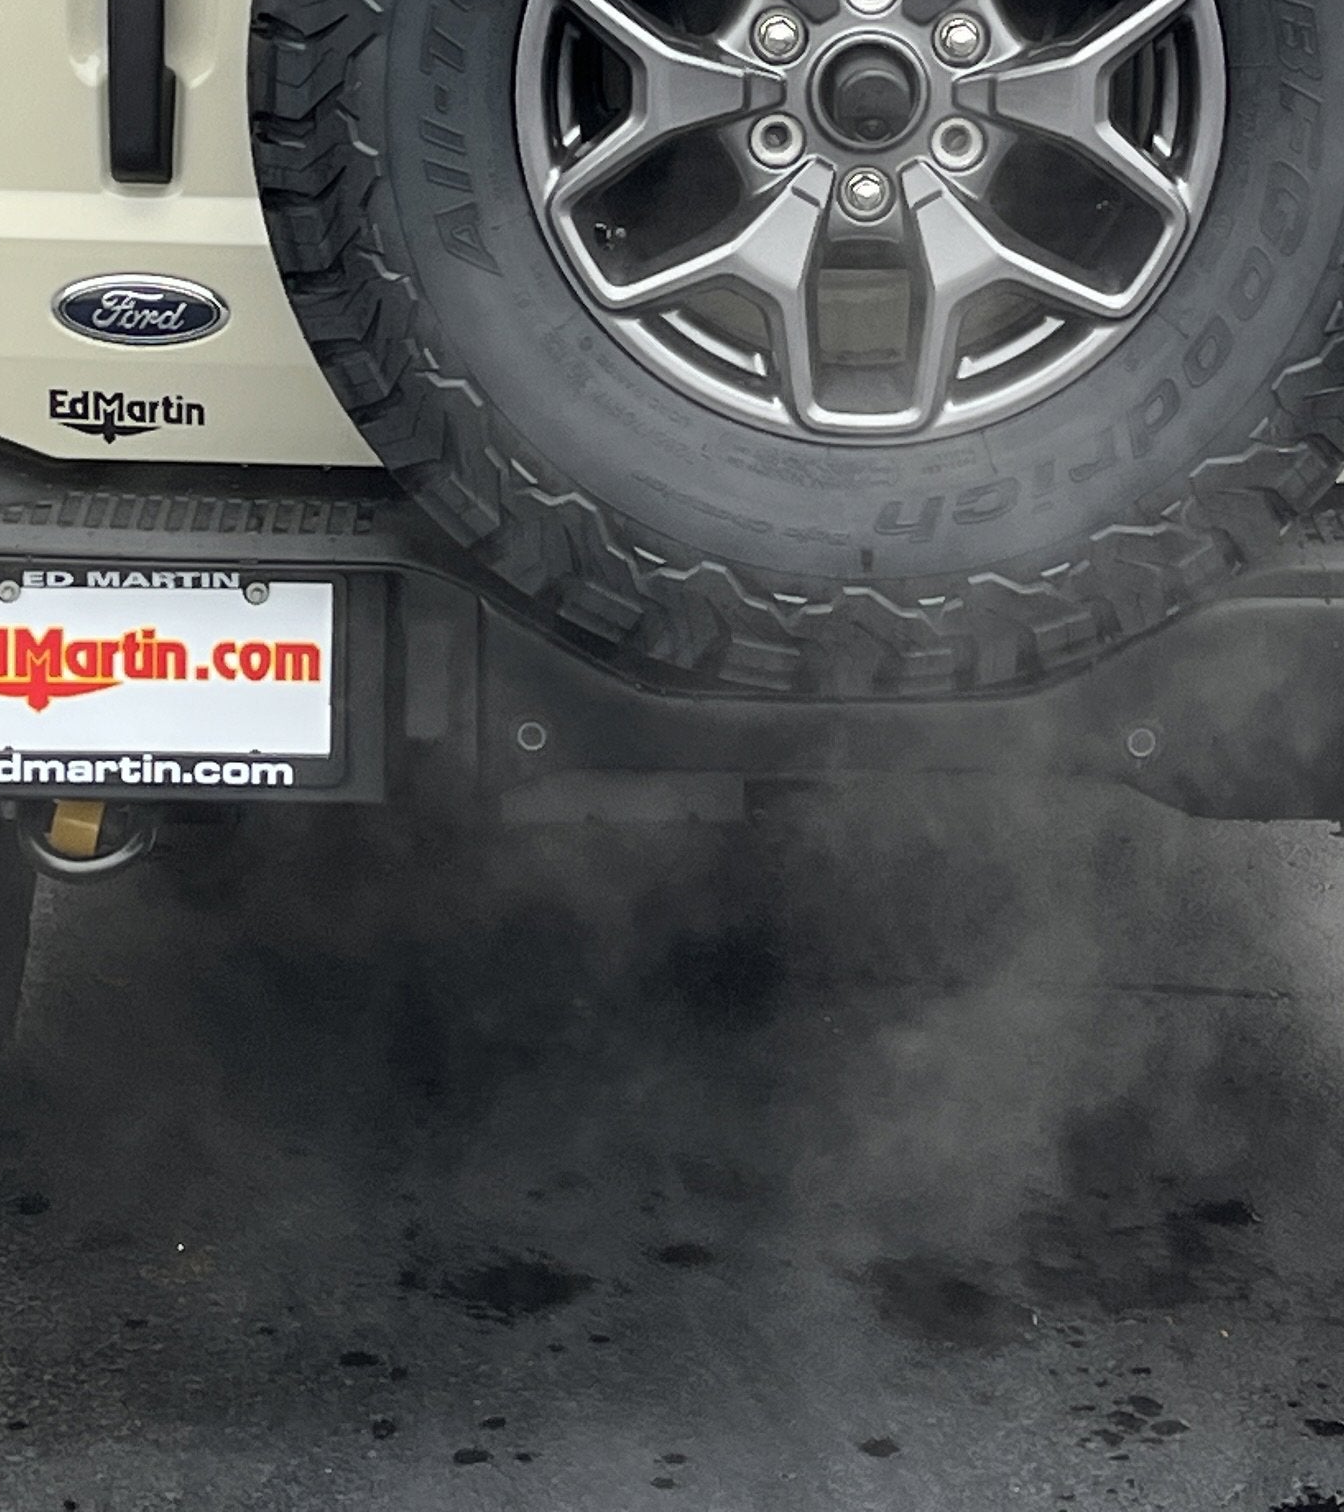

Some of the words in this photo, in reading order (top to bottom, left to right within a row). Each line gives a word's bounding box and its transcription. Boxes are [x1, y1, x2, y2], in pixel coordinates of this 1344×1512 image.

[92, 290, 187, 330] Ford
[22, 571, 74, 588] ED
[87, 571, 240, 589] MARTIN
